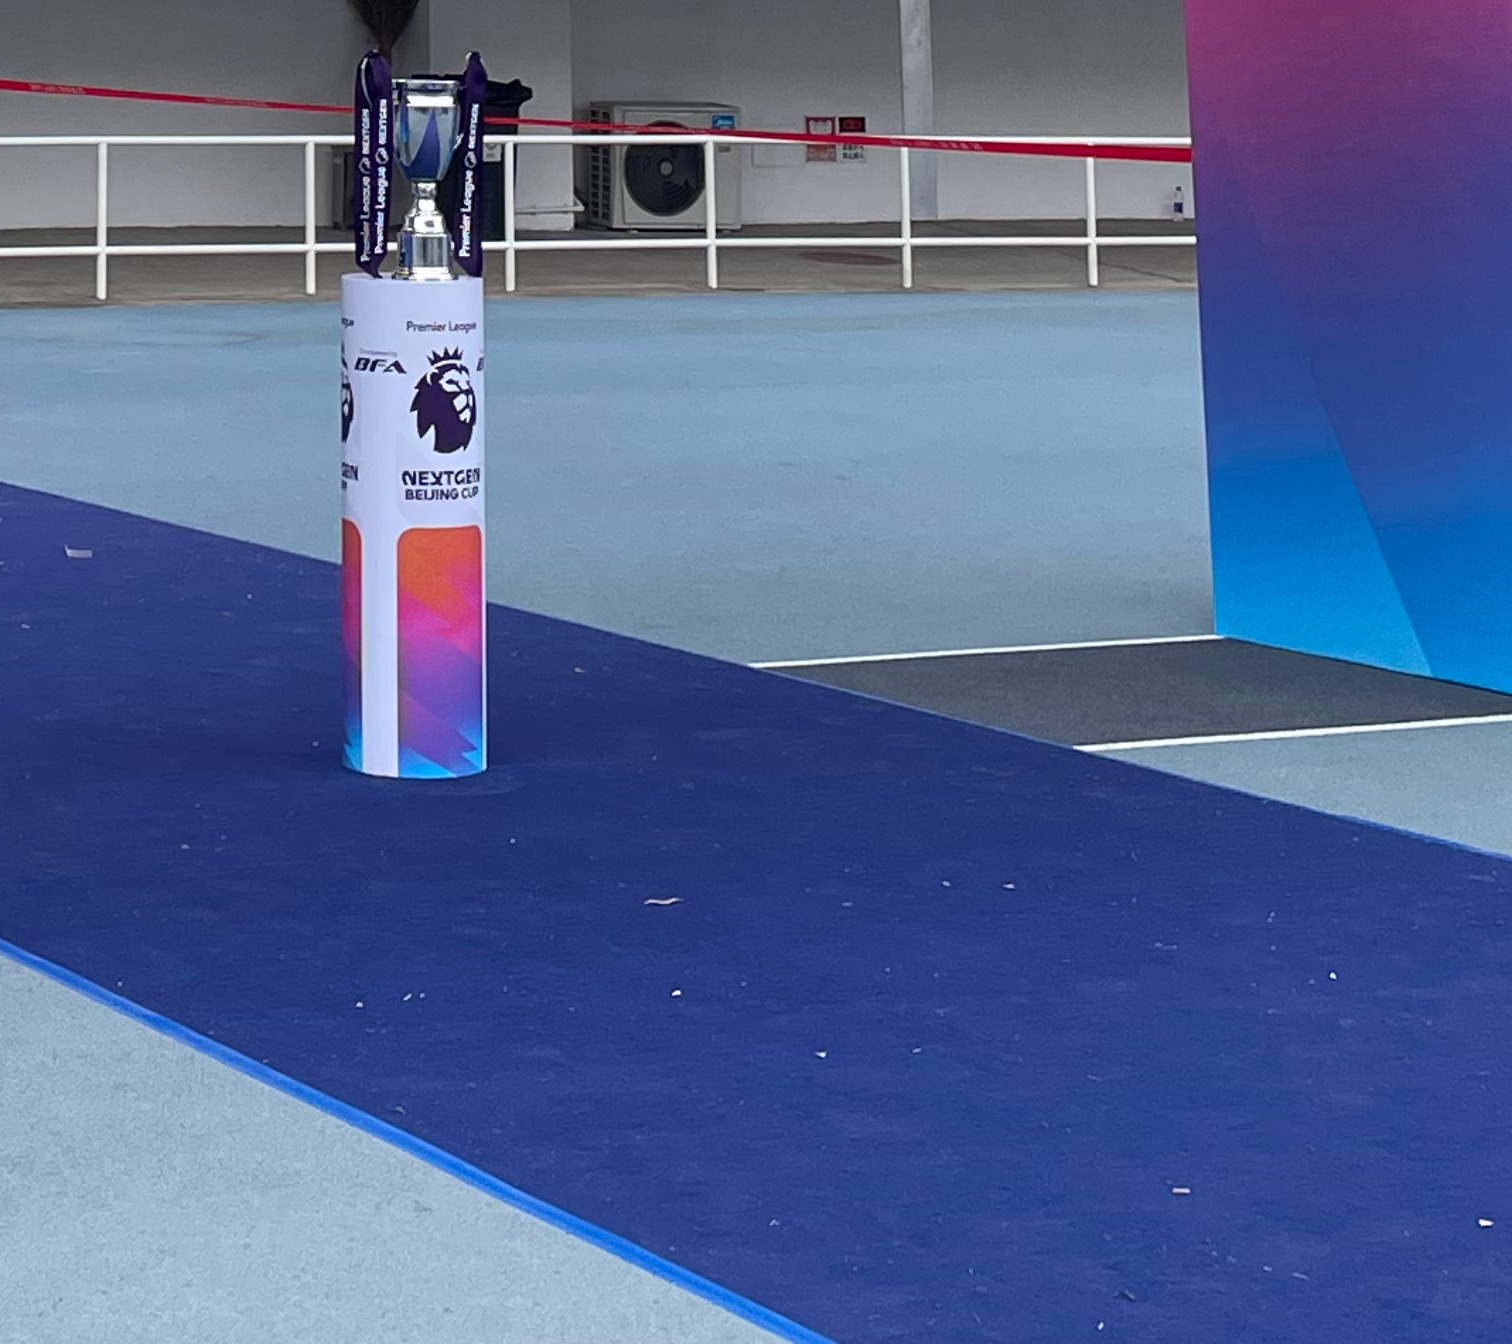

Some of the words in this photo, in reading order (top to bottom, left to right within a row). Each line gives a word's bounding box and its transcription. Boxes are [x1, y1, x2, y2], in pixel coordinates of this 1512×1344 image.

[406, 320, 446, 332] Premier
[354, 357, 407, 374] BFA
[401, 468, 481, 487] NEXTGEN
[404, 488, 459, 501] BEIJING
[460, 486, 479, 499] CUP
